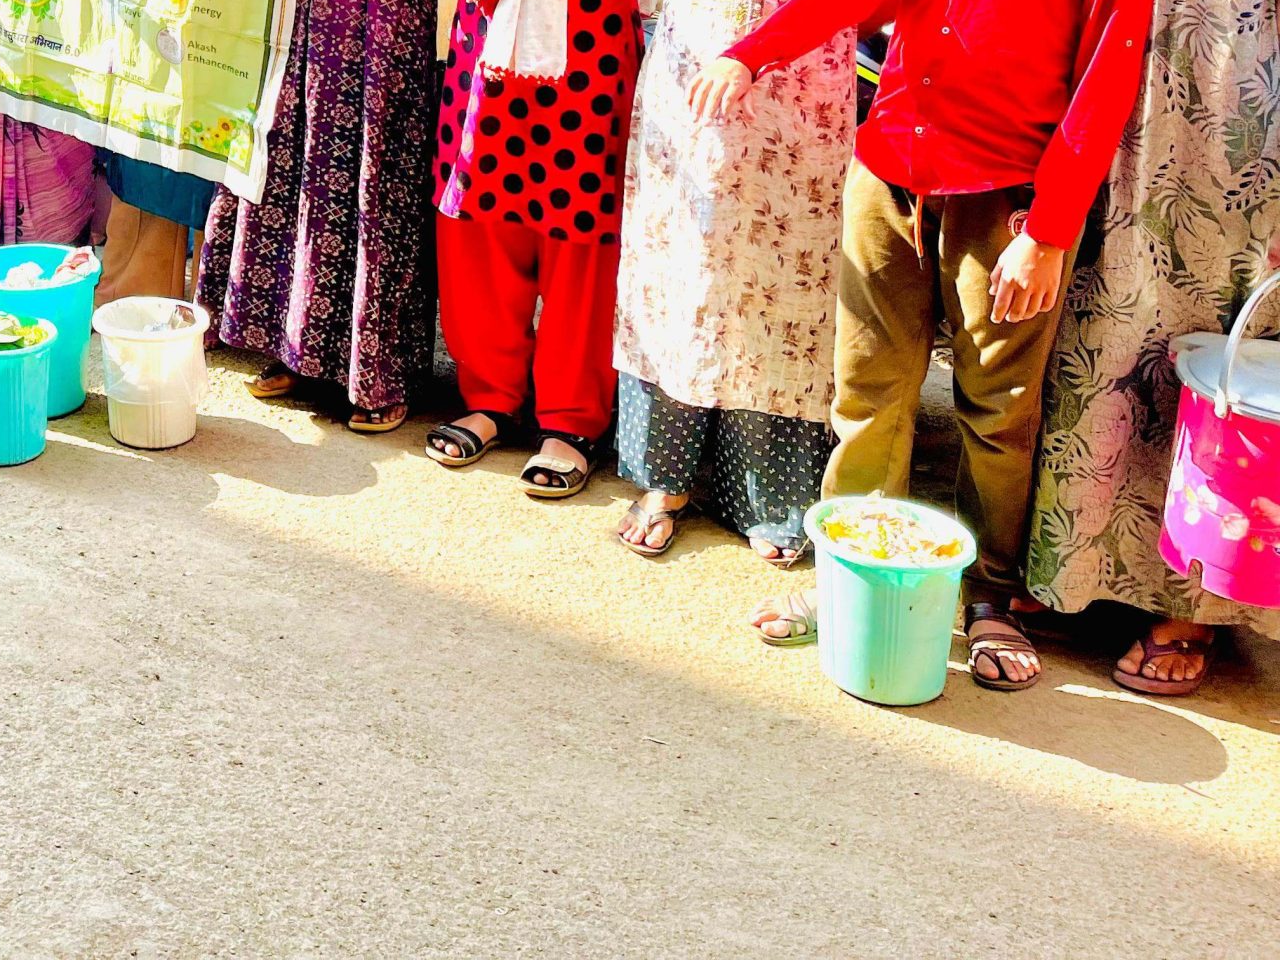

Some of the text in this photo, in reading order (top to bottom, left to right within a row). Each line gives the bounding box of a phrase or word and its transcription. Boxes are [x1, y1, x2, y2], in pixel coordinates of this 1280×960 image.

[191, 5, 222, 19] nergy
[187, 40, 217, 54] Akash
[187, 53, 249, 79] Enhancement
